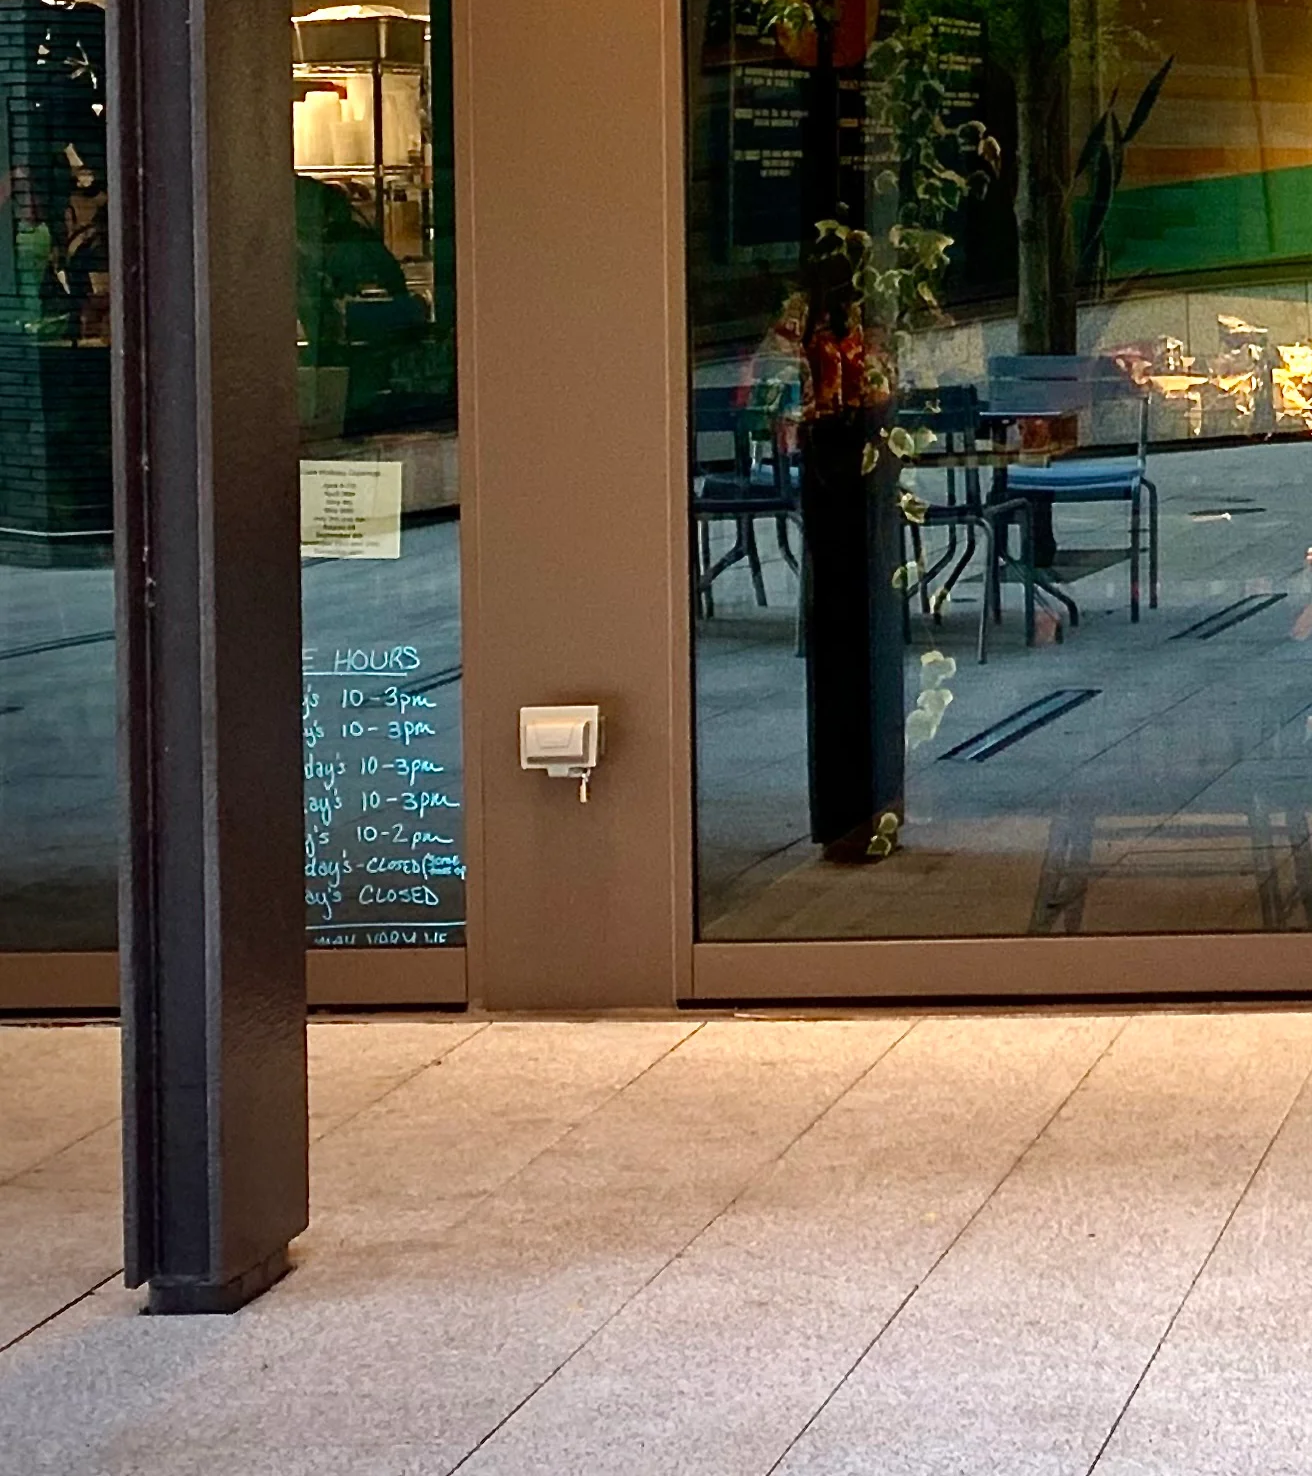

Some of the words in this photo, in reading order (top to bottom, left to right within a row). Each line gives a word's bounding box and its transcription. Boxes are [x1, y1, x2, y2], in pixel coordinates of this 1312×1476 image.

[302, 647, 318, 671] E
[333, 646, 421, 673] HOURS
[304, 752, 347, 791] day's
[304, 849, 353, 889] day's
[304, 886, 342, 921] ay's
[358, 884, 440, 906] CLOSED
